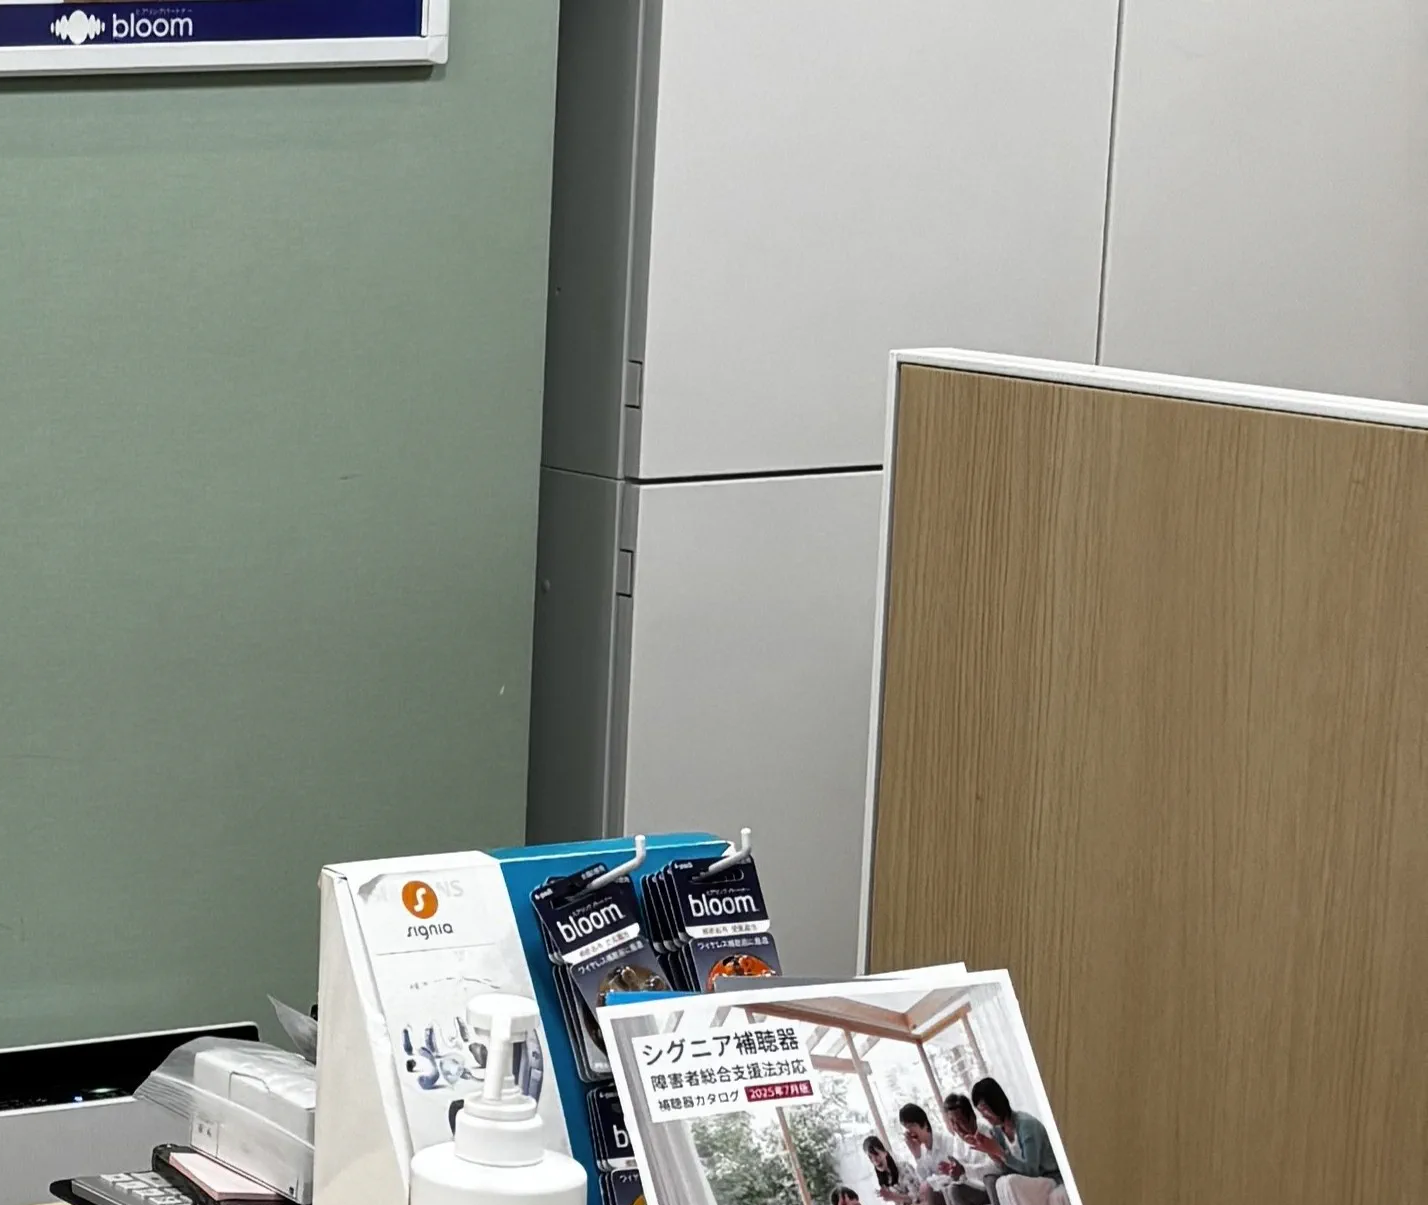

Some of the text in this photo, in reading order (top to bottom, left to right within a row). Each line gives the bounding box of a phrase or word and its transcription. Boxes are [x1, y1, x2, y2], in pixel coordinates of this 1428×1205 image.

[112, 12, 193, 38] bloom
[688, 894, 757, 917] bloom
[407, 923, 453, 940] signia
[557, 903, 625, 943] bloom
[643, 1027, 799, 1066] シグニア補聴器
[651, 1058, 807, 1092] 障害者総合支援法対応
[658, 1083, 812, 1112] 補聴器カタログ 2025年7月版
